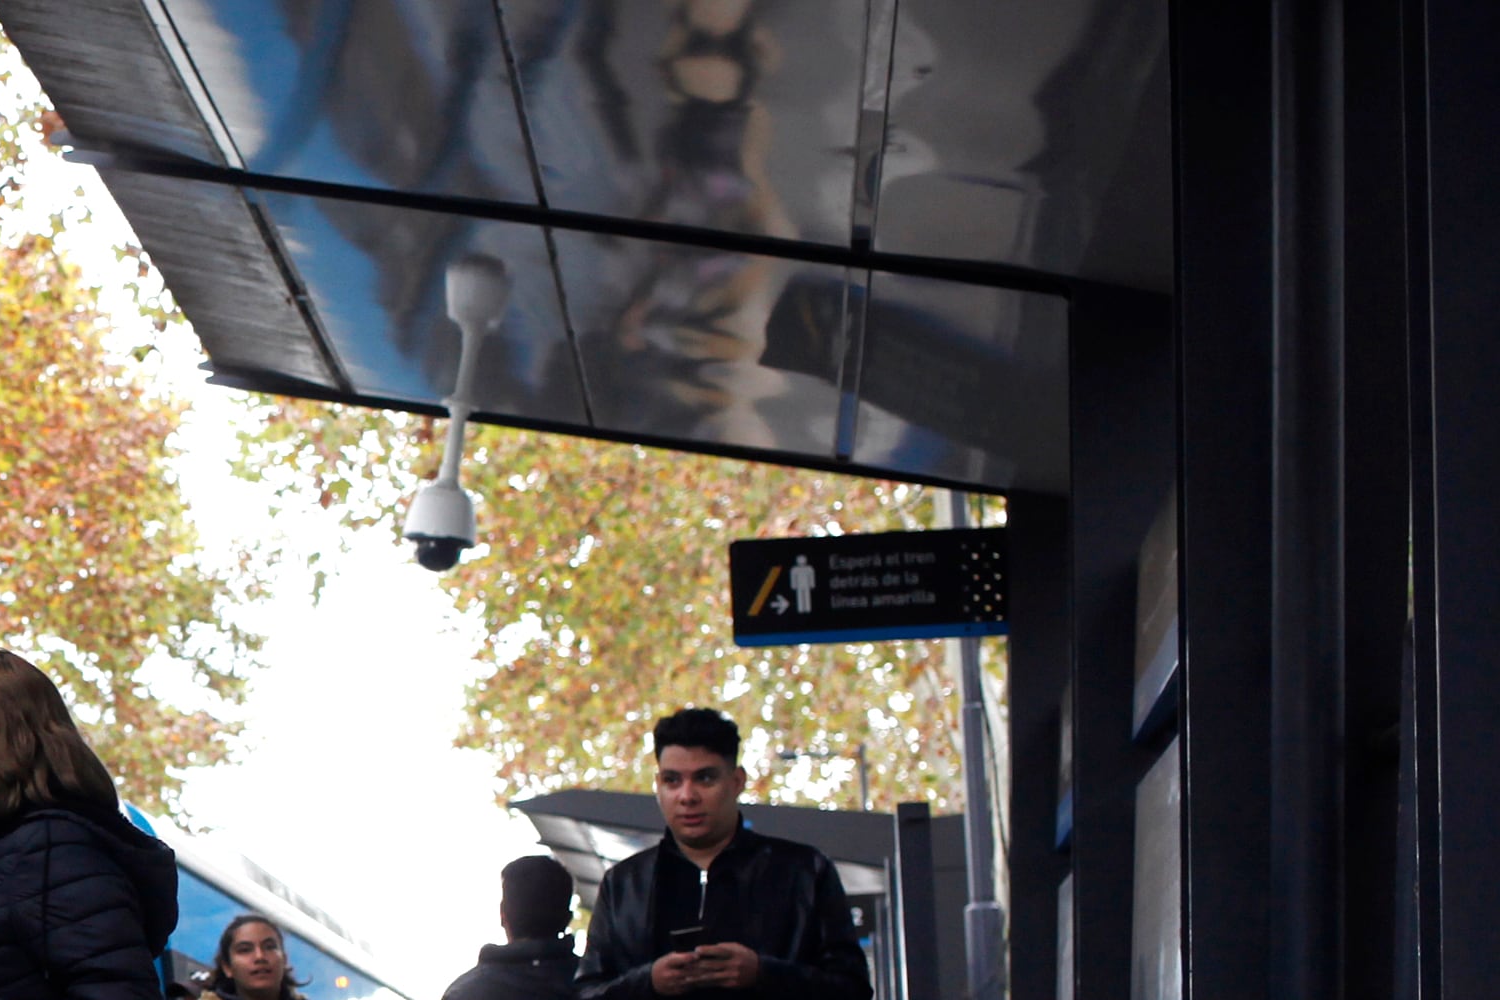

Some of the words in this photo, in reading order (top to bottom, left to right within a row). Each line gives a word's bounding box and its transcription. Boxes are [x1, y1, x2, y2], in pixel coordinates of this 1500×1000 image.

[885, 551, 900, 565] el
[904, 551, 936, 564] tren
[829, 573, 878, 589] detrás
[882, 572, 900, 587] de
[904, 571, 919, 585] la
[872, 590, 936, 606] amarilla
